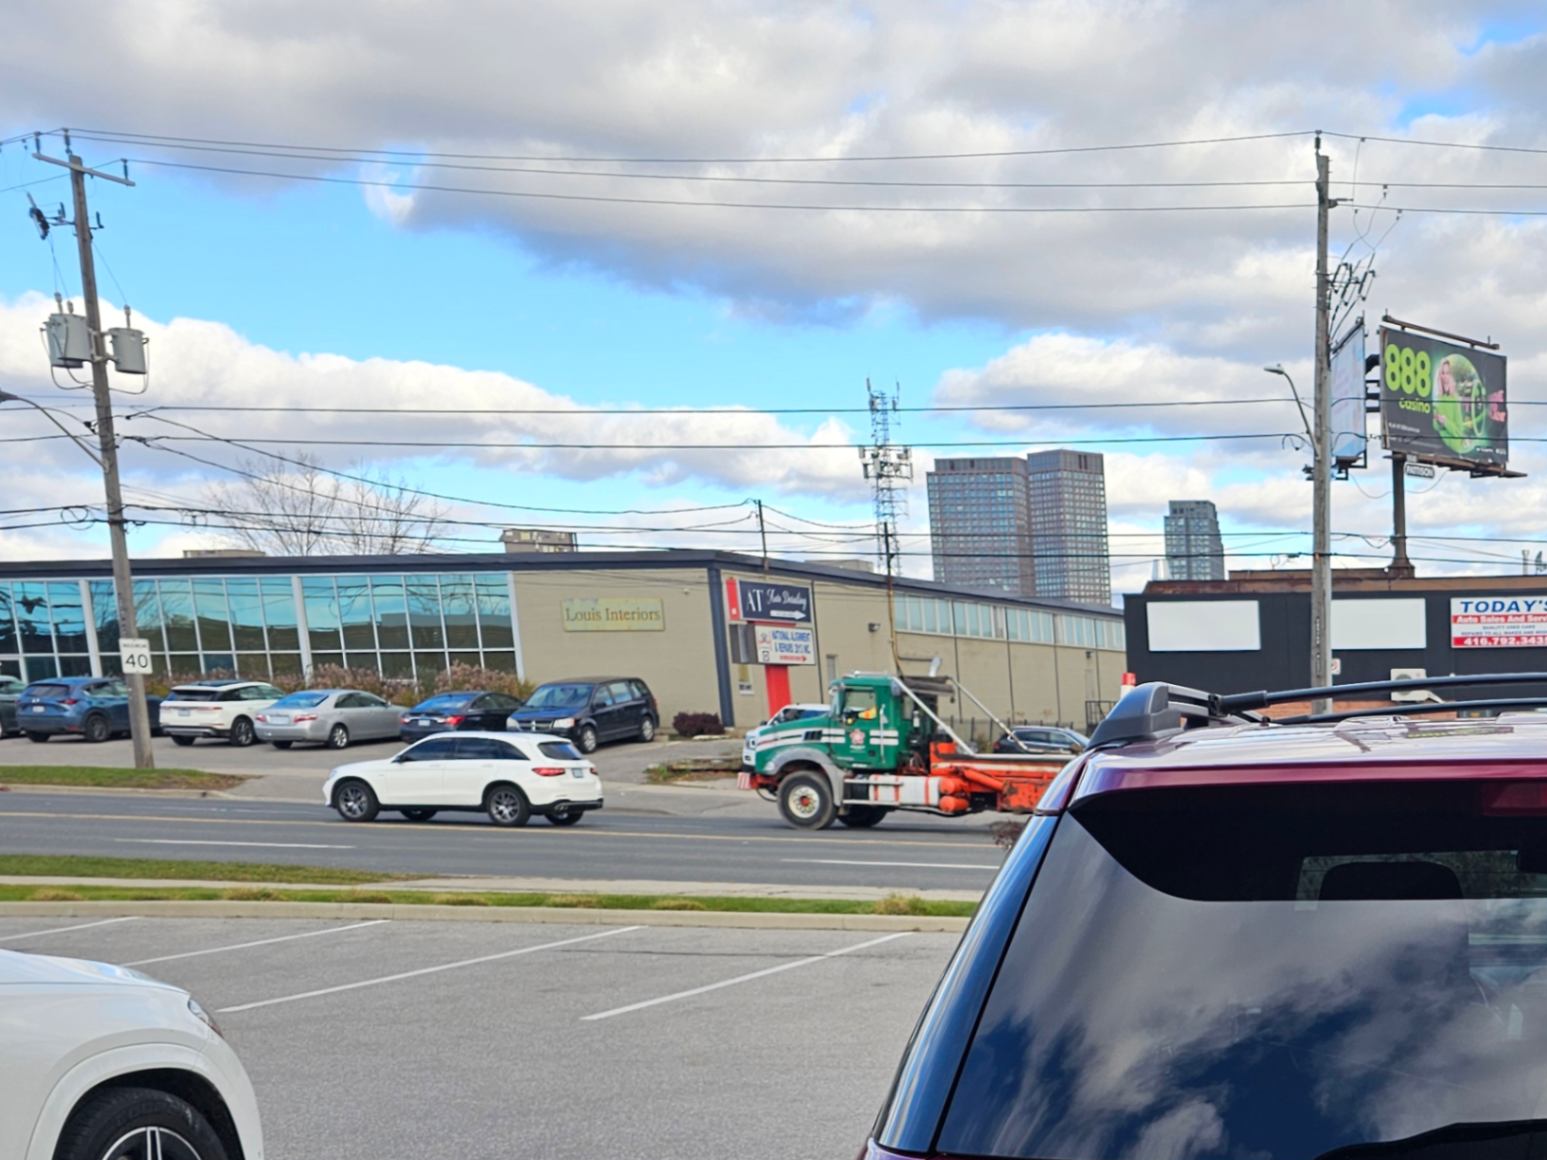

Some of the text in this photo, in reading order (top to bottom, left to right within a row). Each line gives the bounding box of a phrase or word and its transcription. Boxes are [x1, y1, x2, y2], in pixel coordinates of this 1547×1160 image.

[1384, 343, 1431, 397] 888
[746, 589, 763, 611] AT
[565, 607, 661, 621] Louis Interiors
[1456, 616, 1479, 624] Auto
[1480, 615, 1506, 624] Sales
[1507, 615, 1525, 623] And
[125, 654, 148, 668] 40
